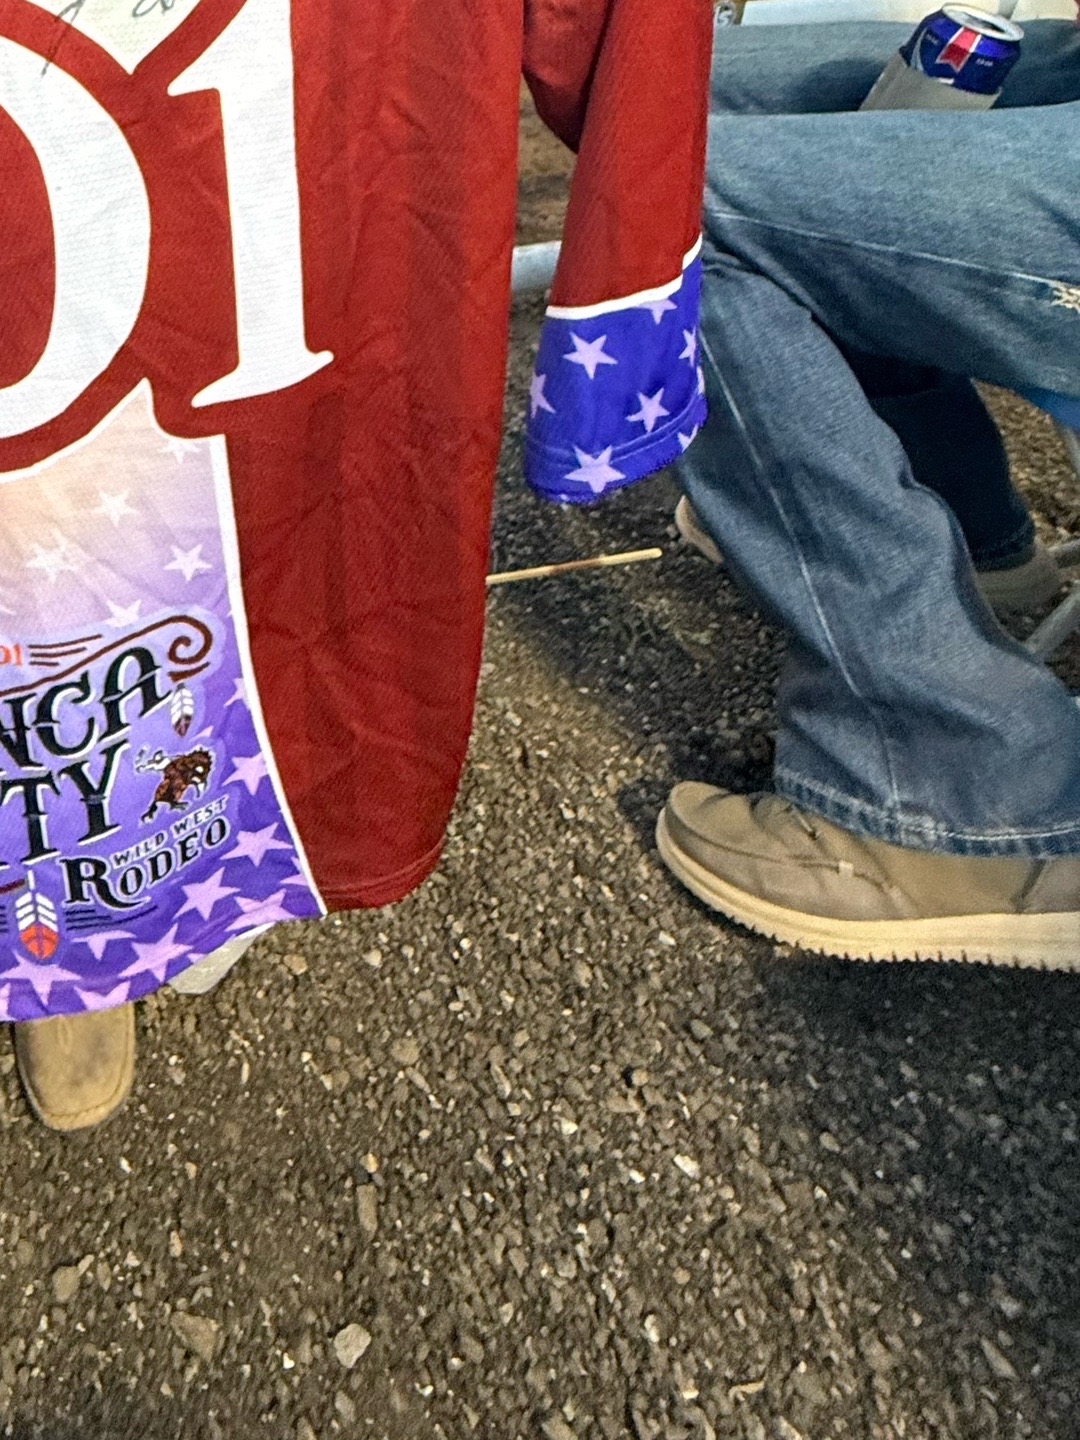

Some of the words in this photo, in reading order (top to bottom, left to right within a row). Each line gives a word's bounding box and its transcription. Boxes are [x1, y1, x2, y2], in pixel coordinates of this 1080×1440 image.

[58, 815, 229, 910] RODEO
[112, 831, 167, 868] WILD
[172, 795, 229, 837] WEST
